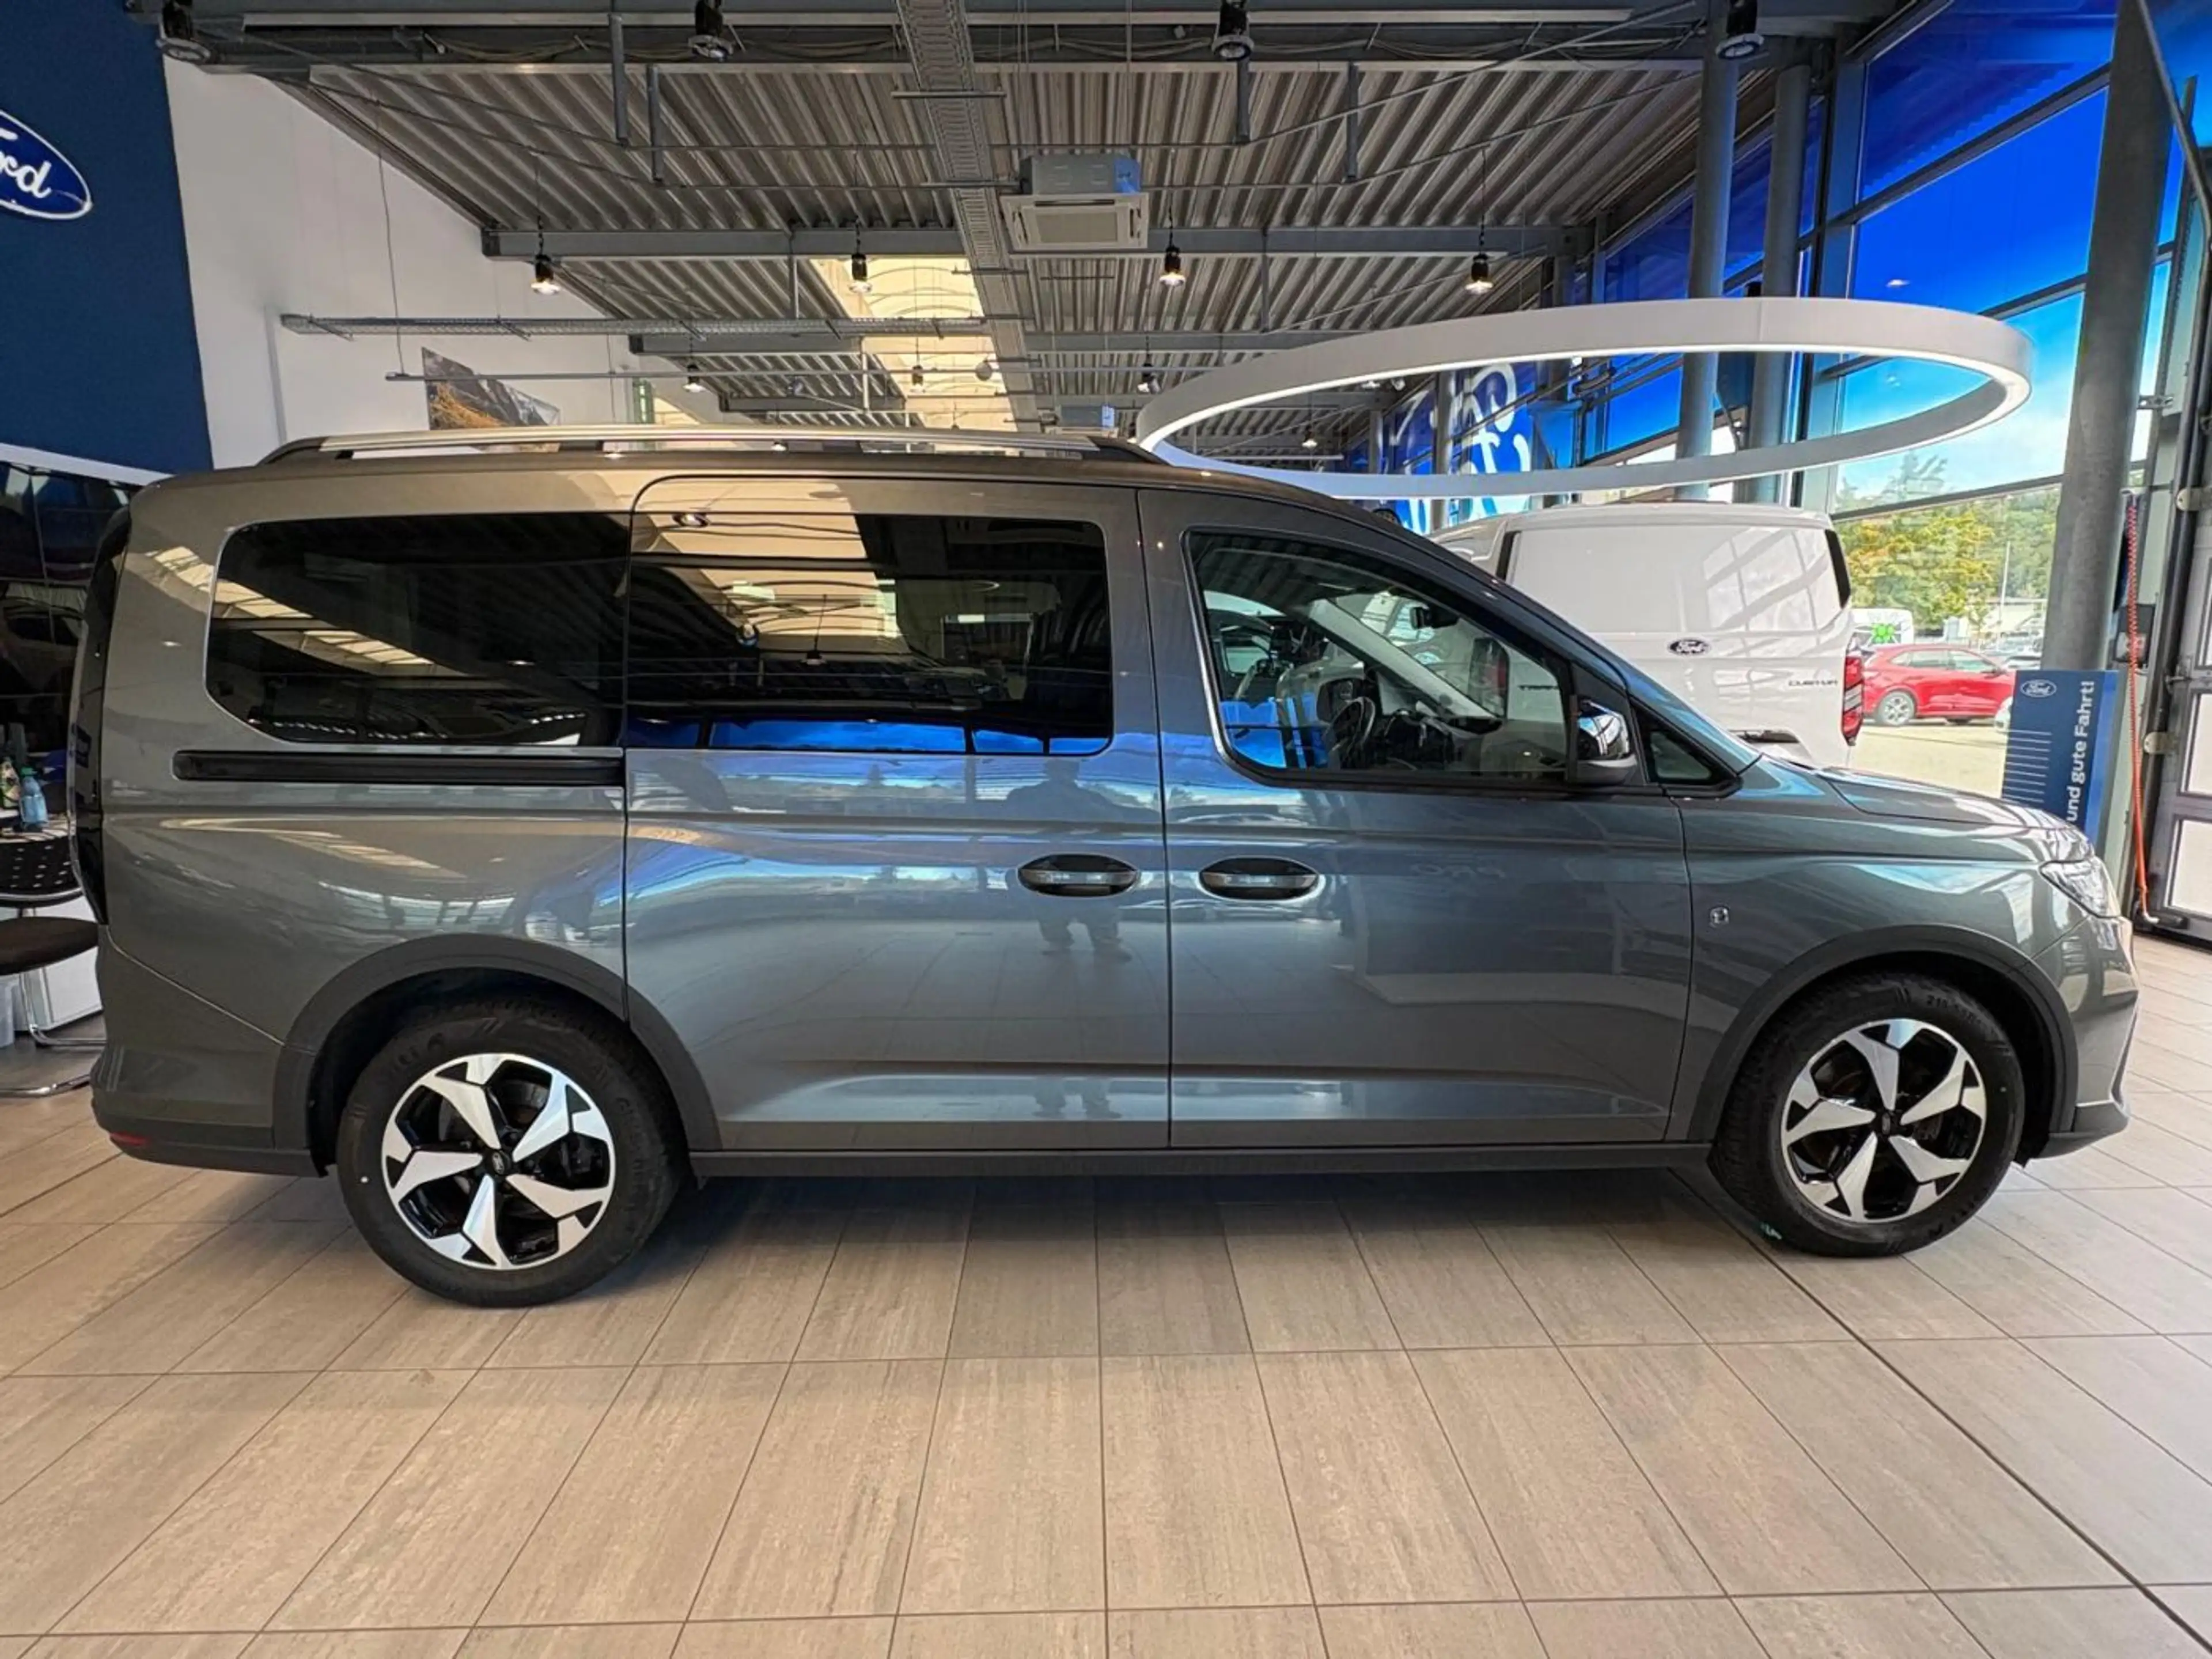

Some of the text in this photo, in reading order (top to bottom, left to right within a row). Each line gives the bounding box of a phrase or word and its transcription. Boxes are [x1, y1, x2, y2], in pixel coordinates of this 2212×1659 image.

[1674, 639, 1707, 654] Ford
[2071, 740, 2088, 784] gute
[2066, 786, 2081, 822] und
